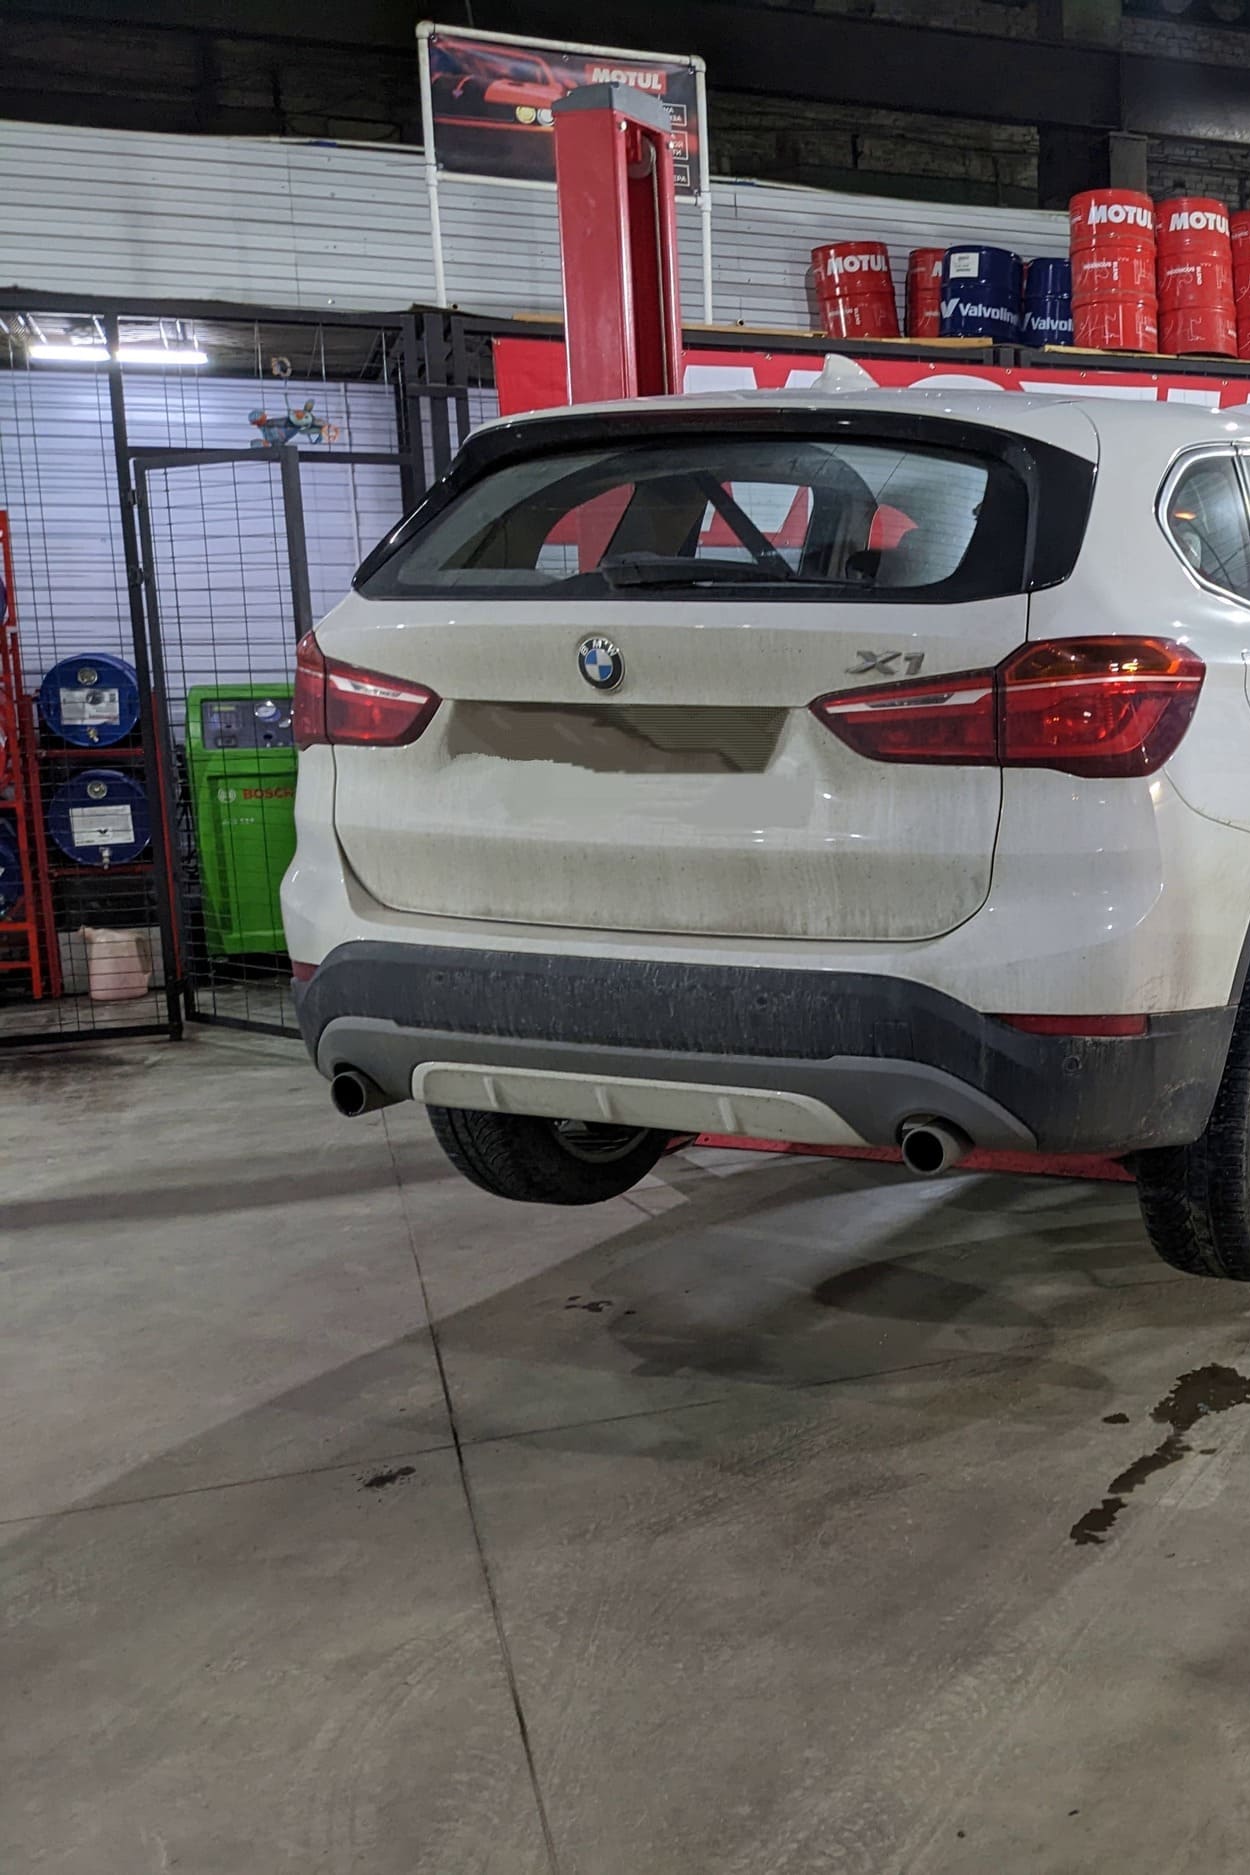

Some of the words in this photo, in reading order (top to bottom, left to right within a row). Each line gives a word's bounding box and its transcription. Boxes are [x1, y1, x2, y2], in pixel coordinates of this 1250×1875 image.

[591, 67, 662, 90] MOTUL
[1088, 204, 1153, 230] MOTUL
[827, 254, 887, 276] MOTUL
[1031, 315, 1074, 332] Valvol
[844, 650, 925, 675] X1
